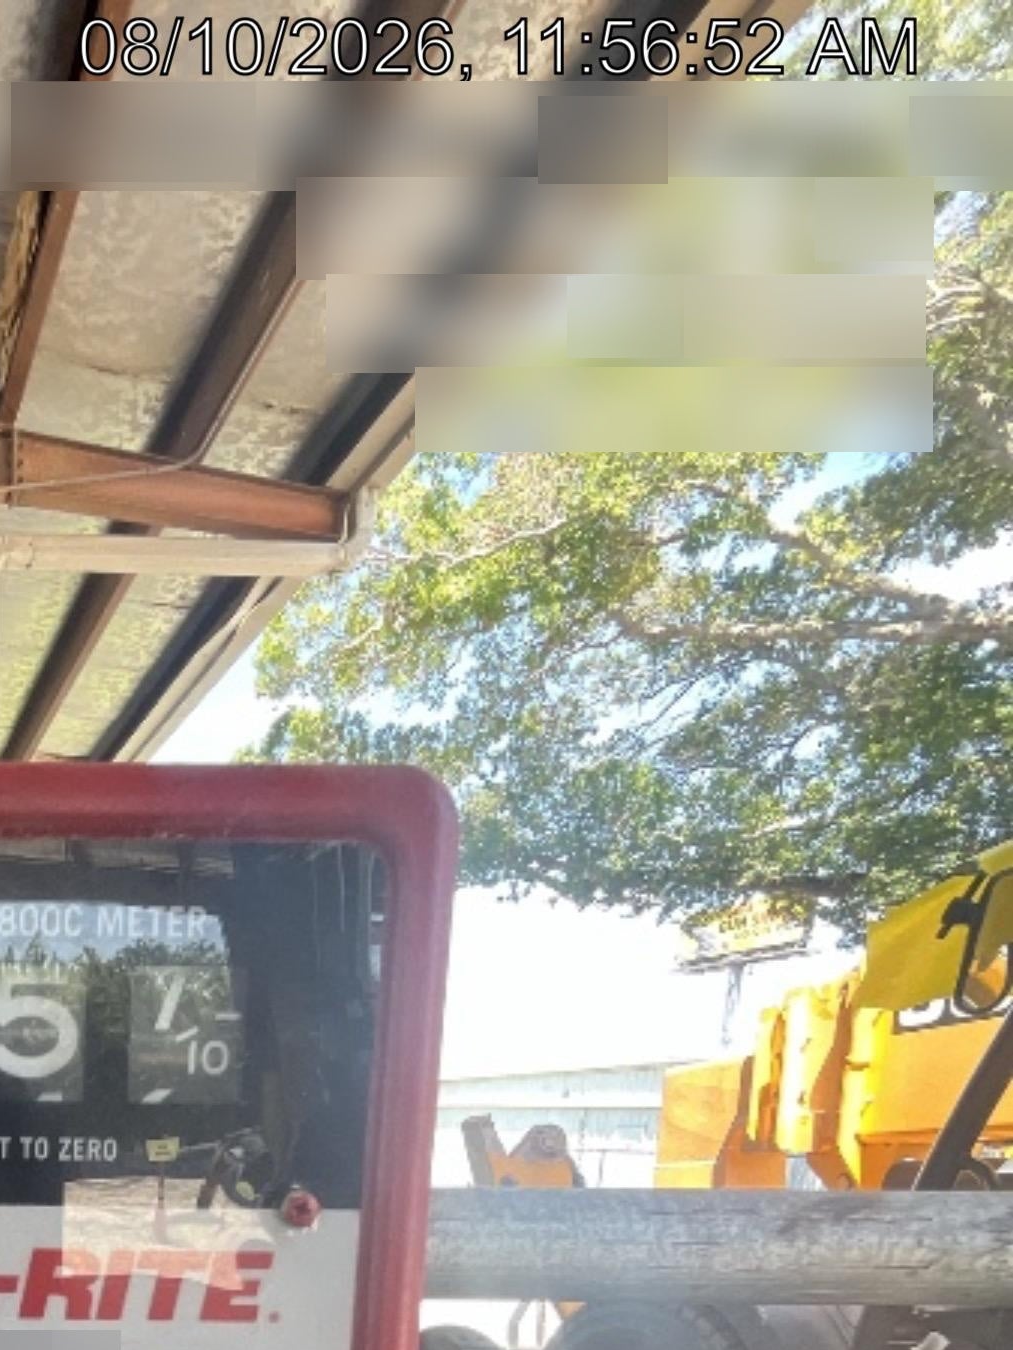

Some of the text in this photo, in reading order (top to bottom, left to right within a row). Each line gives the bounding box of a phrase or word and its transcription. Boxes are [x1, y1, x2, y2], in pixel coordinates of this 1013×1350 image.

[96, 904, 207, 939] METER
[19, 1136, 49, 1160] TO
[58, 1137, 117, 1161] ZERO
